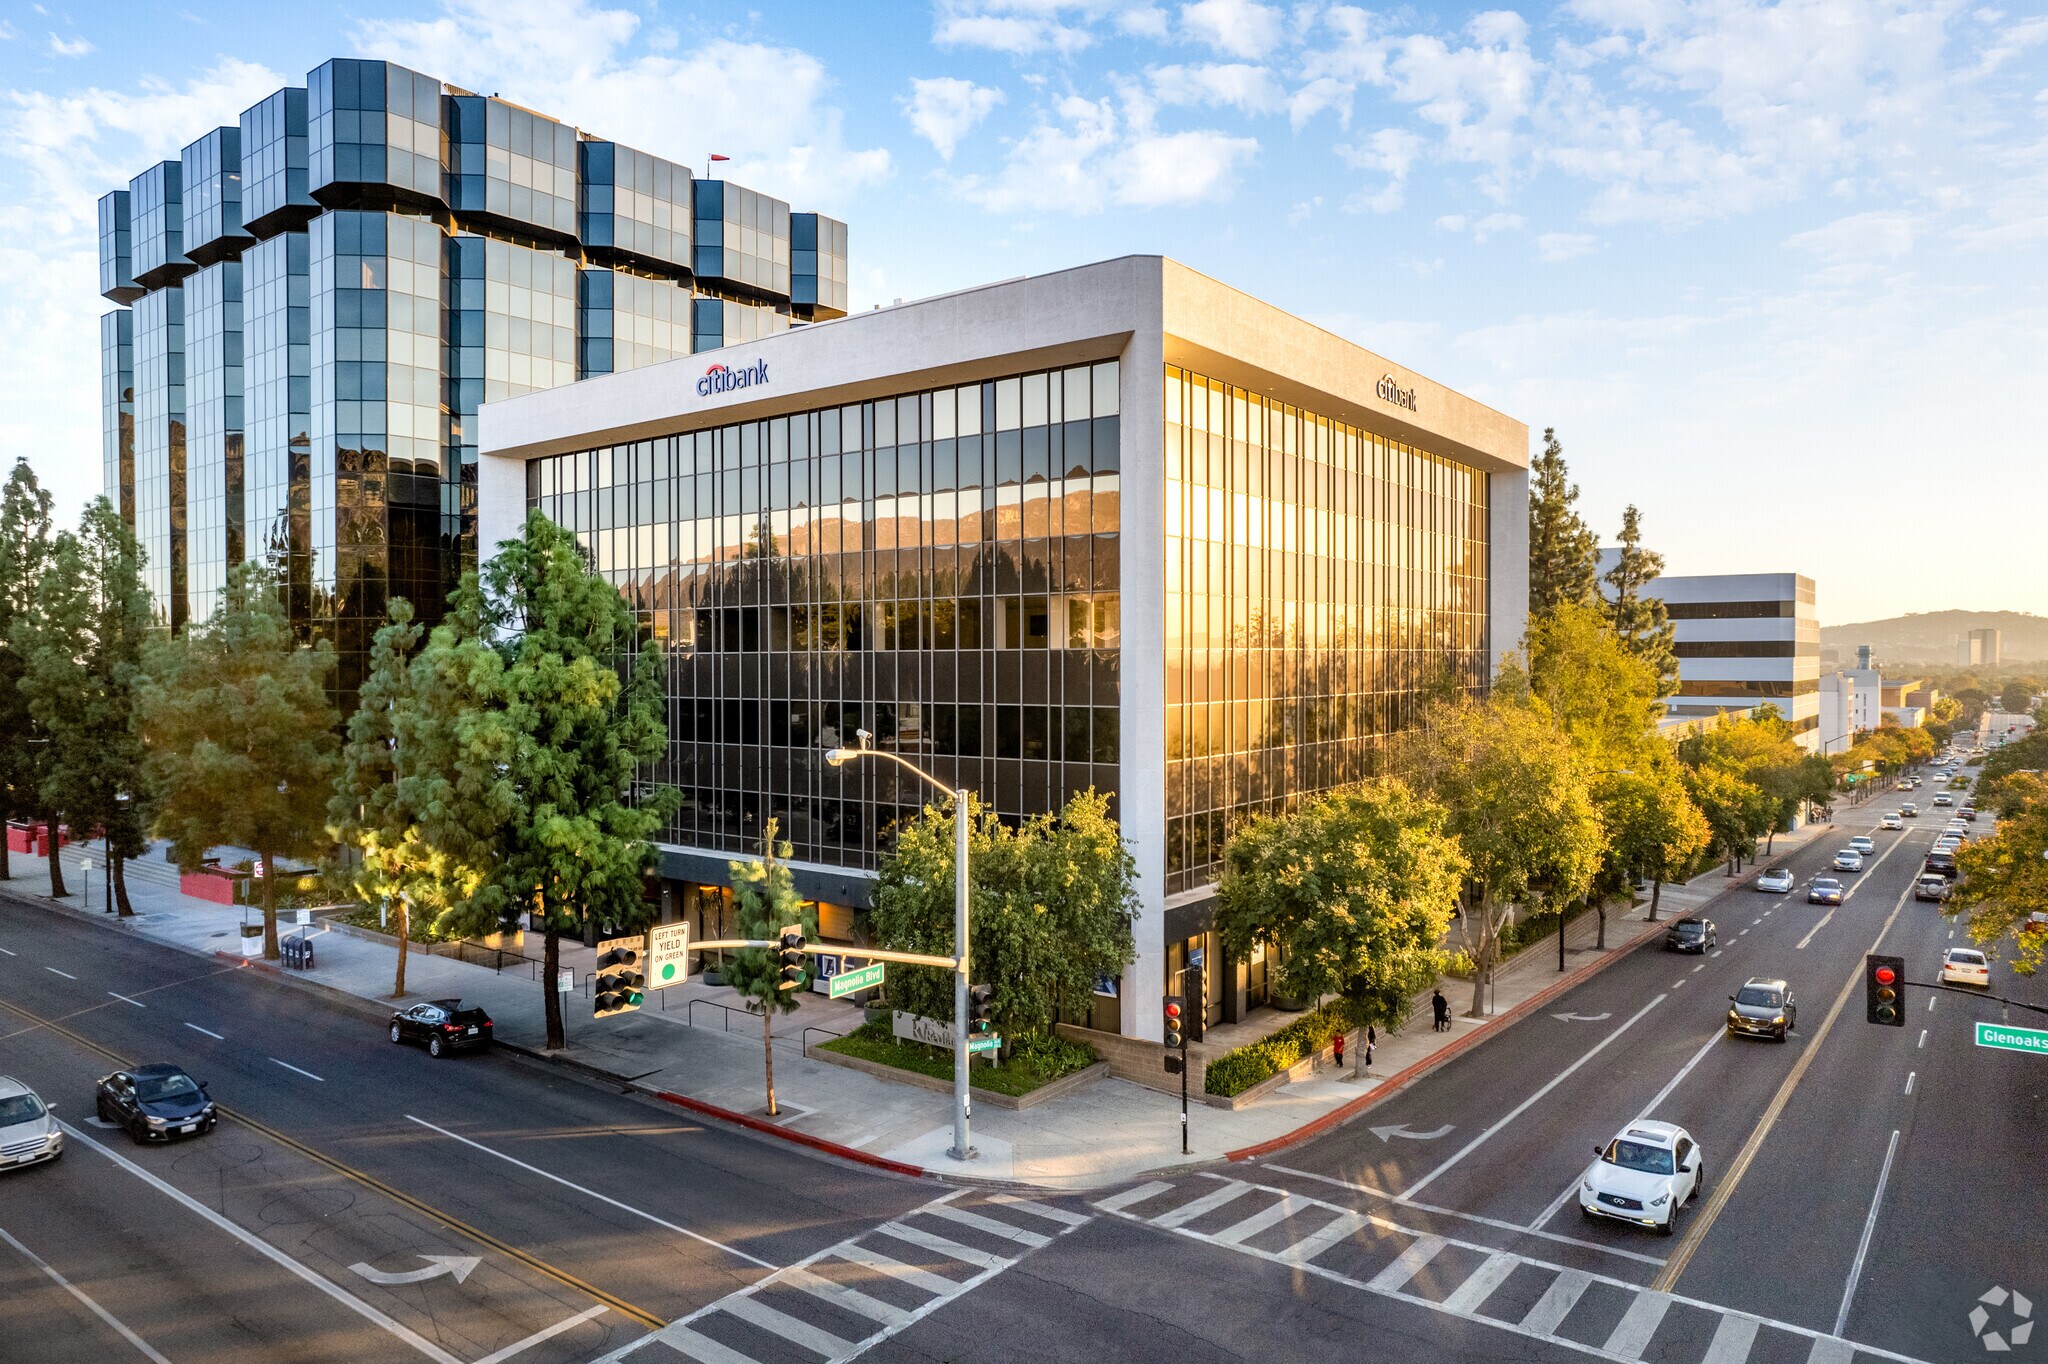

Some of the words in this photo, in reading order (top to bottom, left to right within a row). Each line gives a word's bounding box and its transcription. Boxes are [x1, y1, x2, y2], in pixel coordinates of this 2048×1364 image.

[696, 358, 769, 396] citibank
[1376, 374, 1417, 412] citibank
[655, 931, 669, 941] LEFT
[670, 928, 686, 938] TURN
[659, 939, 681, 952] YIELD
[655, 954, 664, 963] ON
[665, 950, 684, 961] GREEN
[834, 974, 864, 992] Magnolia
[865, 968, 881, 983] Blvd
[969, 1039, 993, 1051] Magnolia
[1984, 1029, 2048, 1049] Glenoaks
